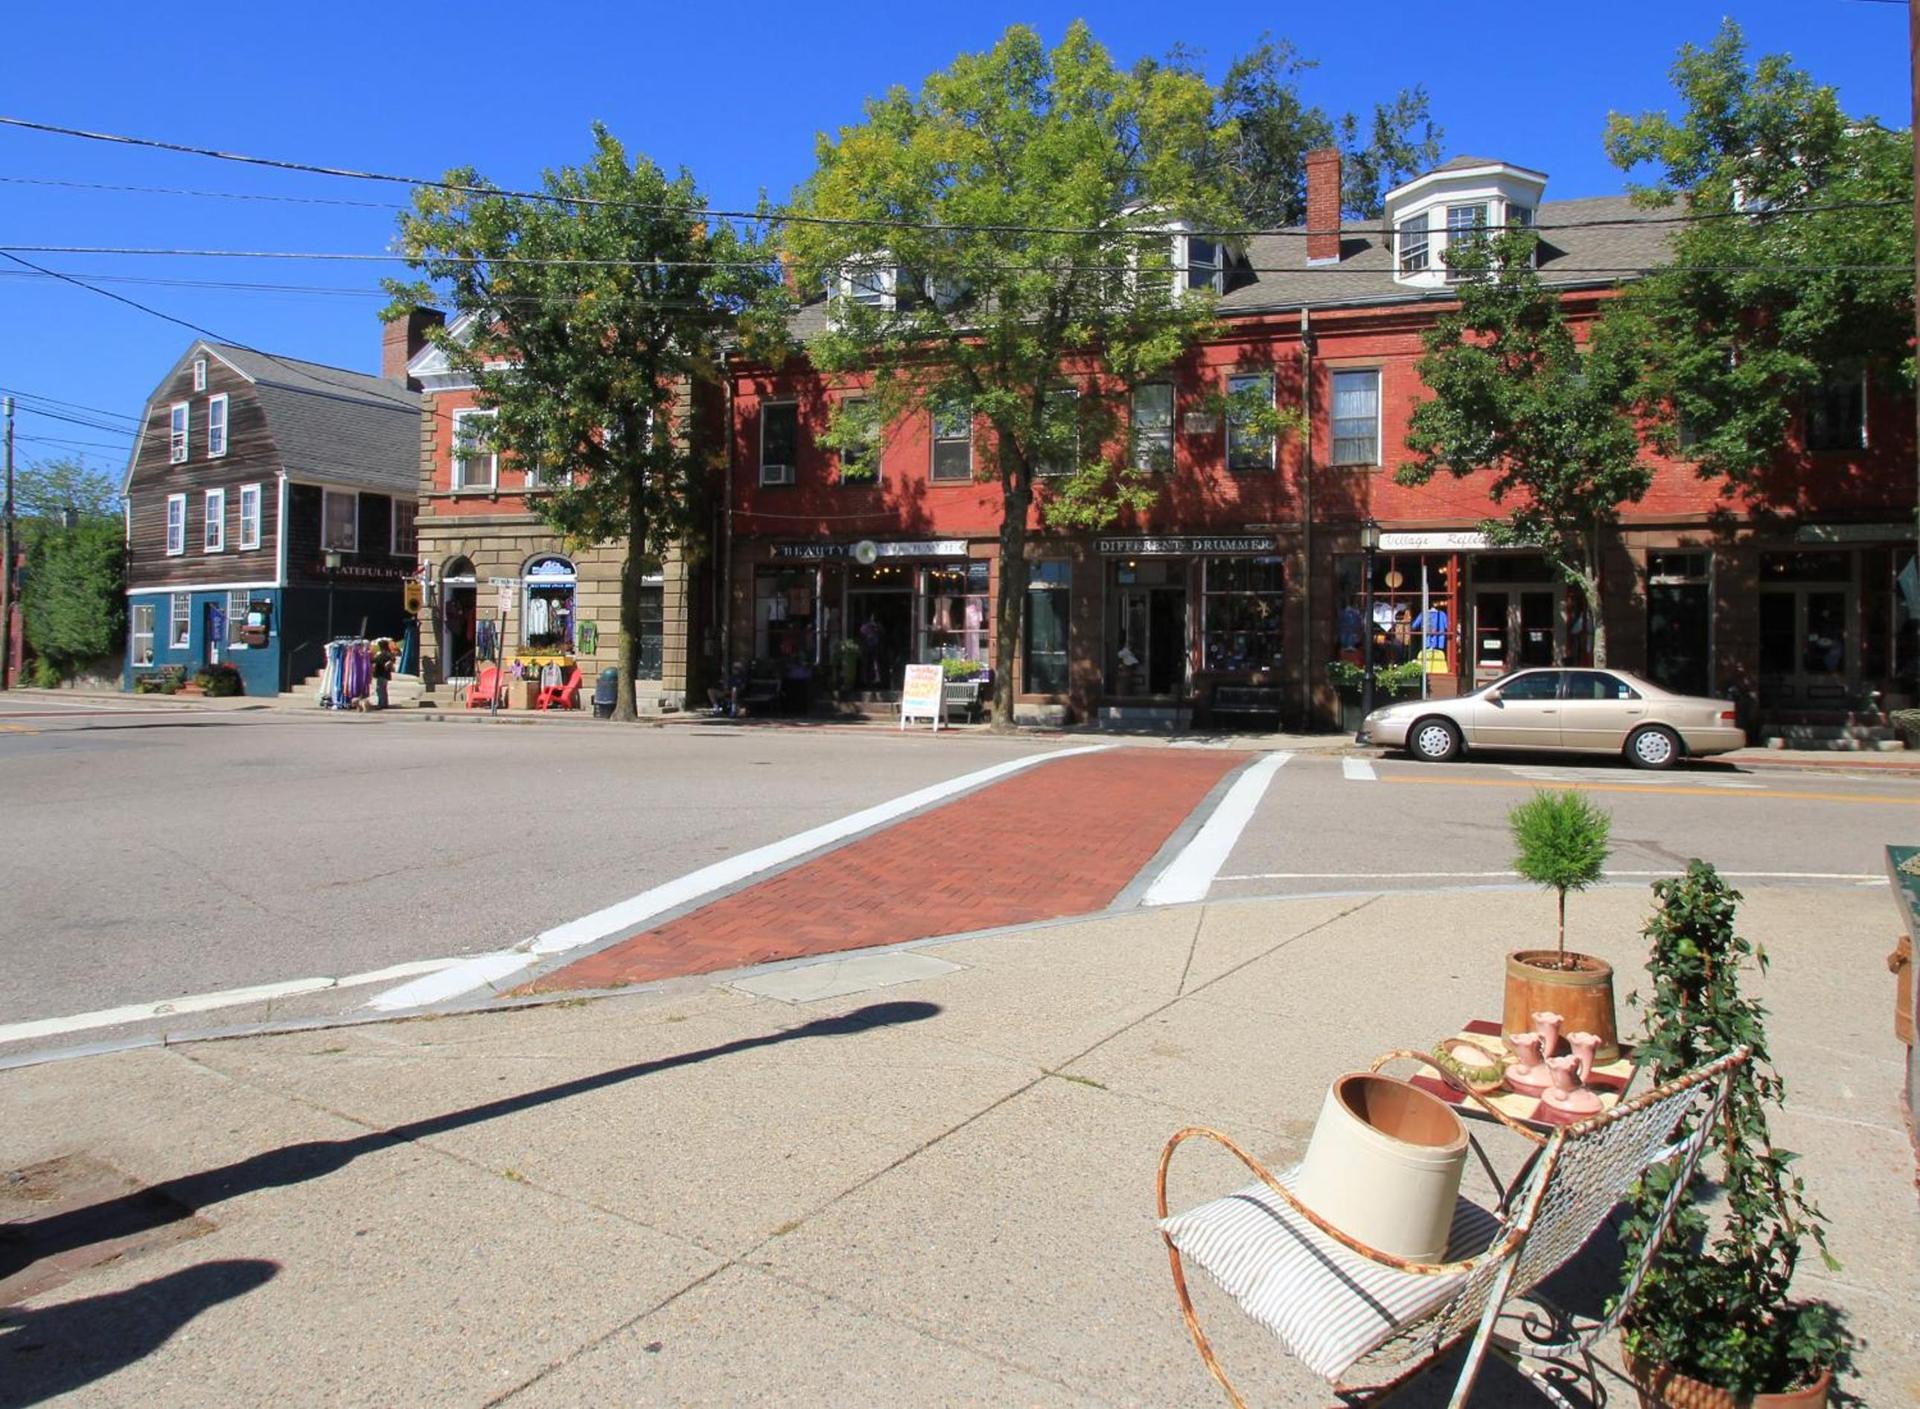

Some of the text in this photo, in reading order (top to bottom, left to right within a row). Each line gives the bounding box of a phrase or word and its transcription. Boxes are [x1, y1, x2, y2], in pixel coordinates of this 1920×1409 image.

[1100, 538, 1274, 551] DIFFERENT DRUMMER
[1385, 534, 1488, 547] Village Reflec
[784, 545, 845, 556] BEAUTY
[321, 566, 383, 577] GATEFUL
